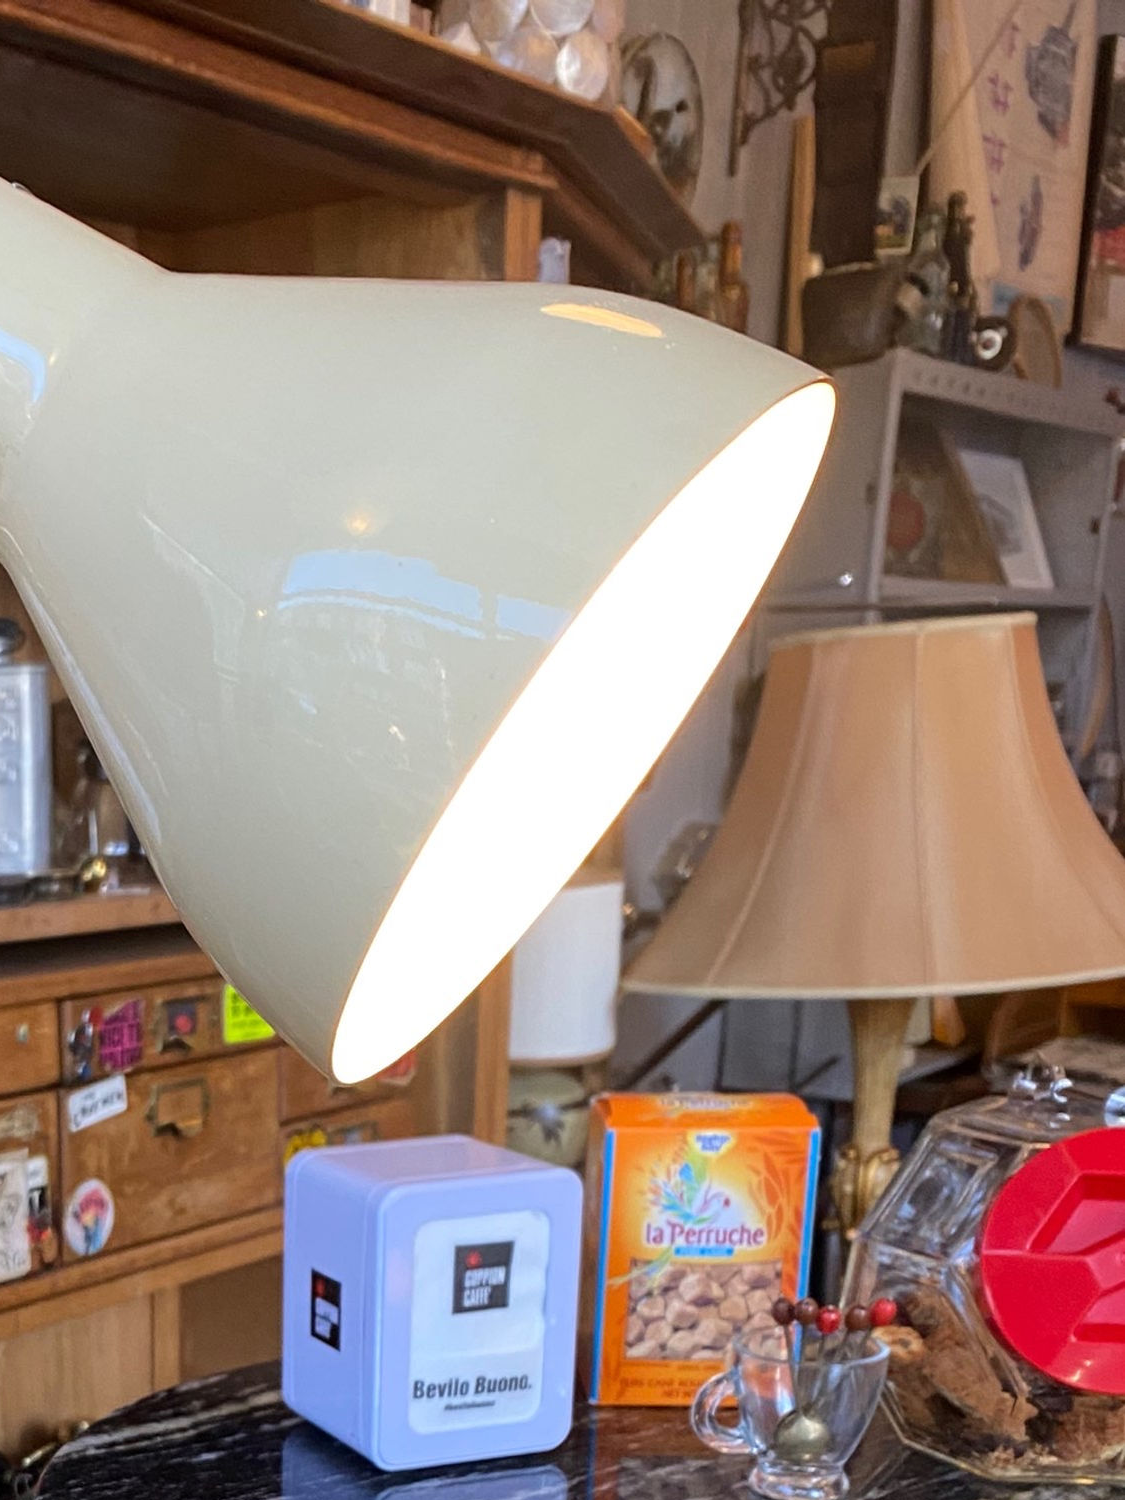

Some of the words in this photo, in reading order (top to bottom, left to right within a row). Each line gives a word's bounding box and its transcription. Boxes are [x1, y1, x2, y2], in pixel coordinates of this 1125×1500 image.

[646, 1223, 664, 1245] la
[666, 1219, 764, 1246] Perruche
[413, 1377, 470, 1400] Bevilo
[474, 1374, 533, 1397] Buono.
